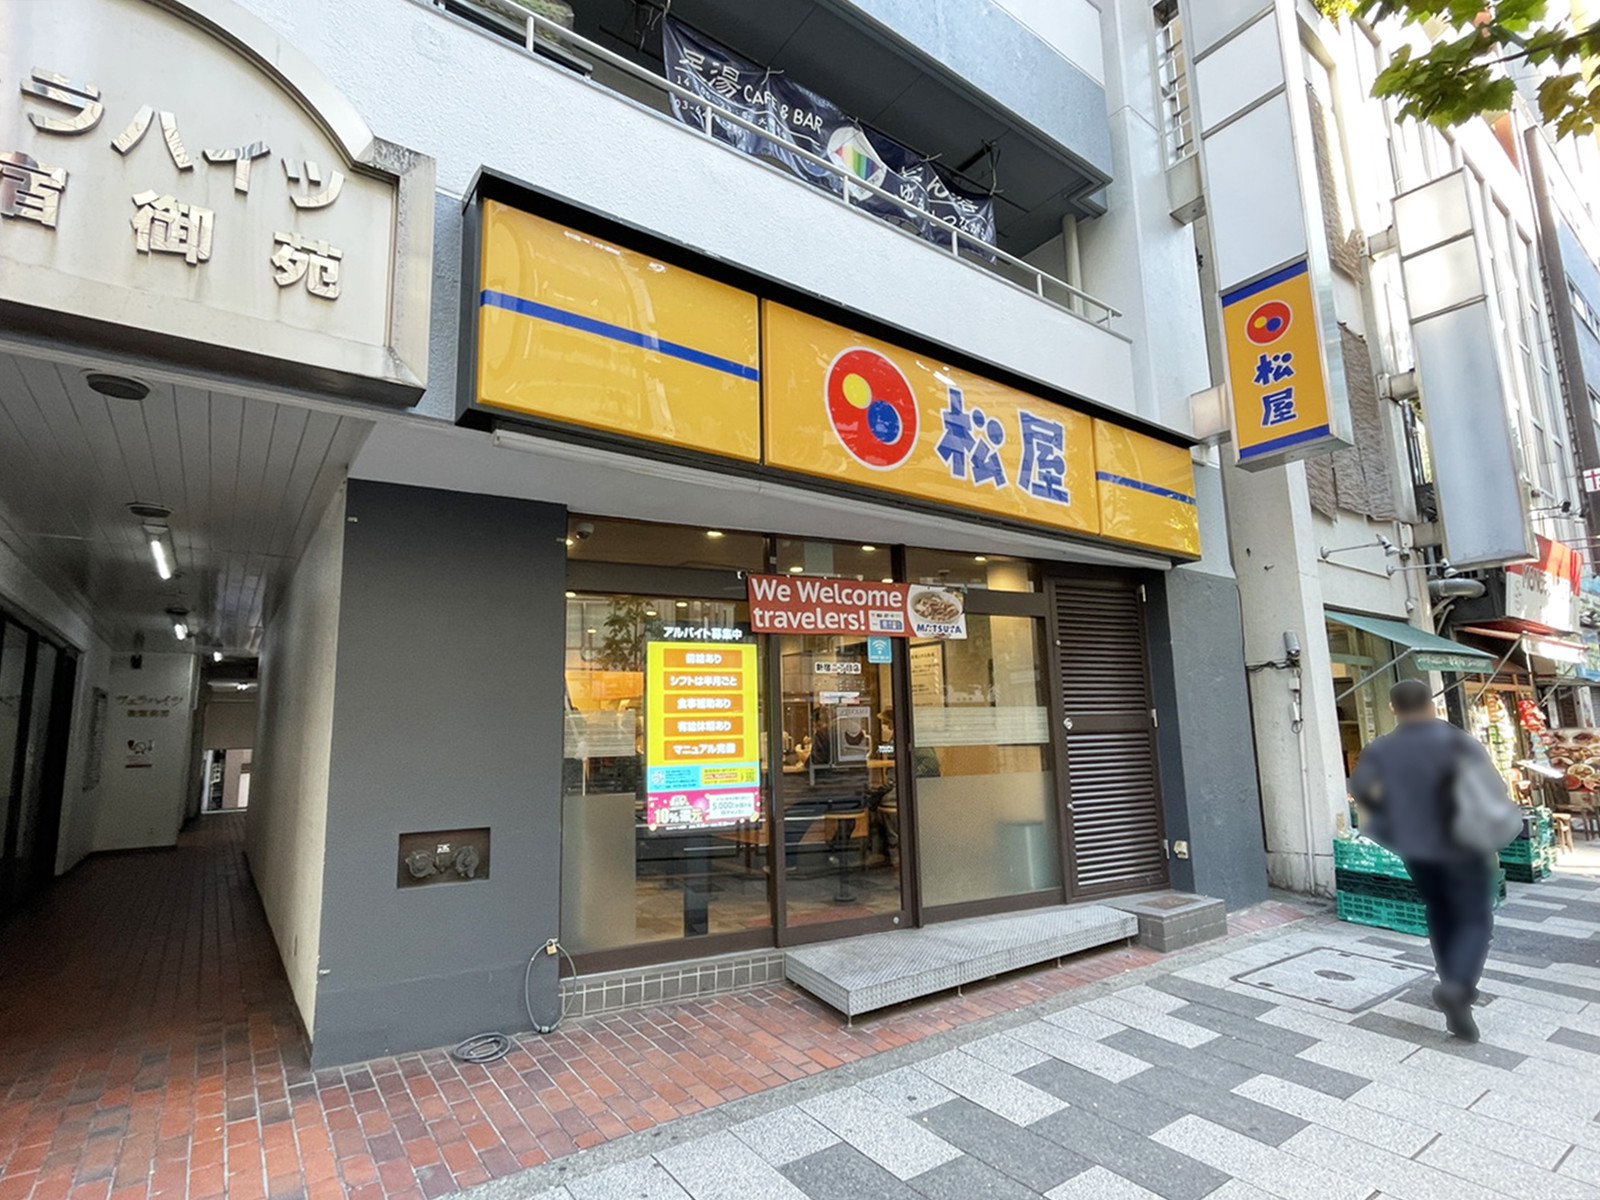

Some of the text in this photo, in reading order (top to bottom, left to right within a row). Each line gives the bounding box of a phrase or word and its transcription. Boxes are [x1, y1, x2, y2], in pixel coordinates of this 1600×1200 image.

[743, 85, 825, 136] CAFE & BAR
[19, 65, 345, 210] ラハイツ
[1252, 351, 1298, 427] 松屋
[934, 385, 1071, 507] 松屋
[751, 578, 903, 608] We Welcome
[663, 626, 743, 641] アルバイト募集中
[753, 608, 866, 632] travelers!
[669, 674, 738, 687] シフトは半月ごと
